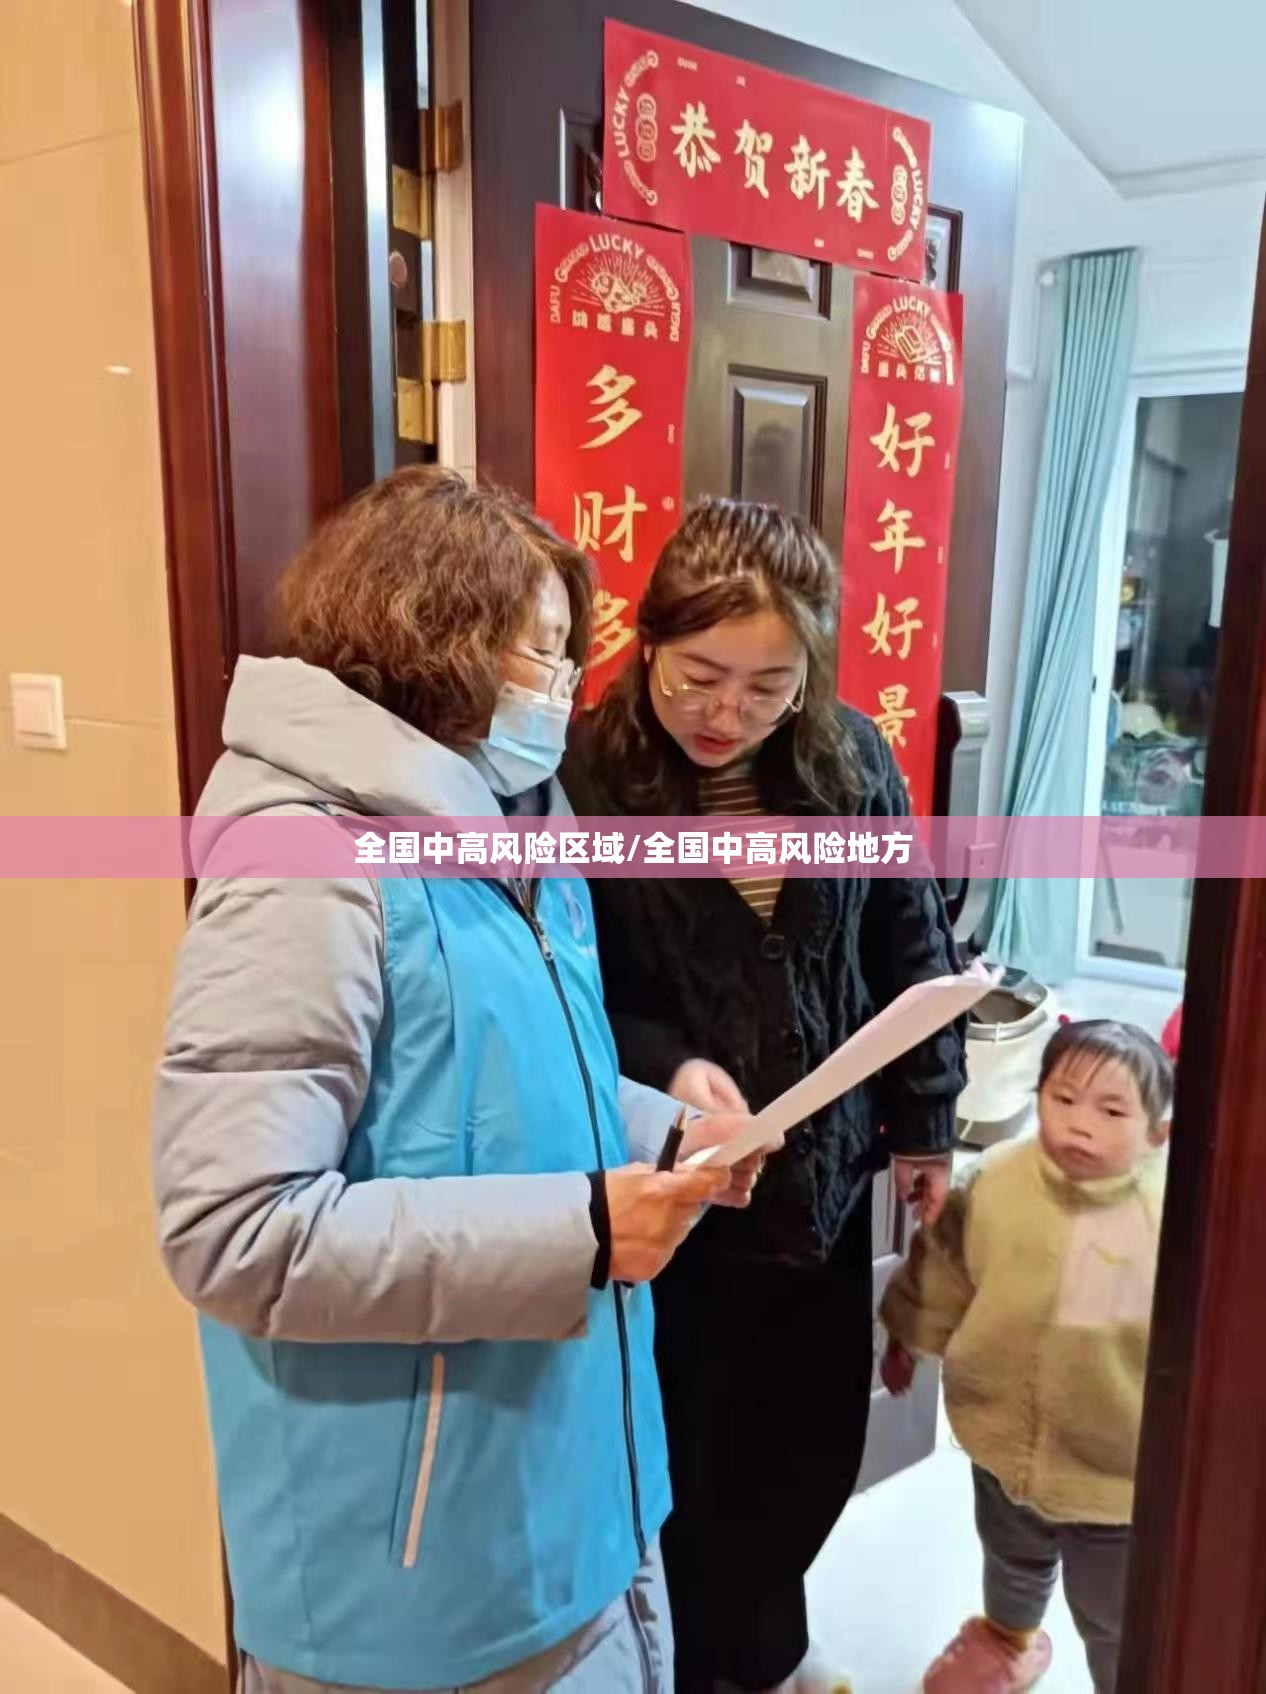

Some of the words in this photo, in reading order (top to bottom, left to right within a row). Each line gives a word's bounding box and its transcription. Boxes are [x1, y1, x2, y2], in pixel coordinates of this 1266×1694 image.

[613, 86, 630, 158] LUCKY
[670, 101, 880, 224] 恭贺新春
[910, 169, 924, 230] LUCKY
[589, 232, 645, 260] LUCKY
[892, 295, 932, 317] LUCKY
[573, 363, 648, 669] 多财多
[862, 402, 936, 806] 好年好景
